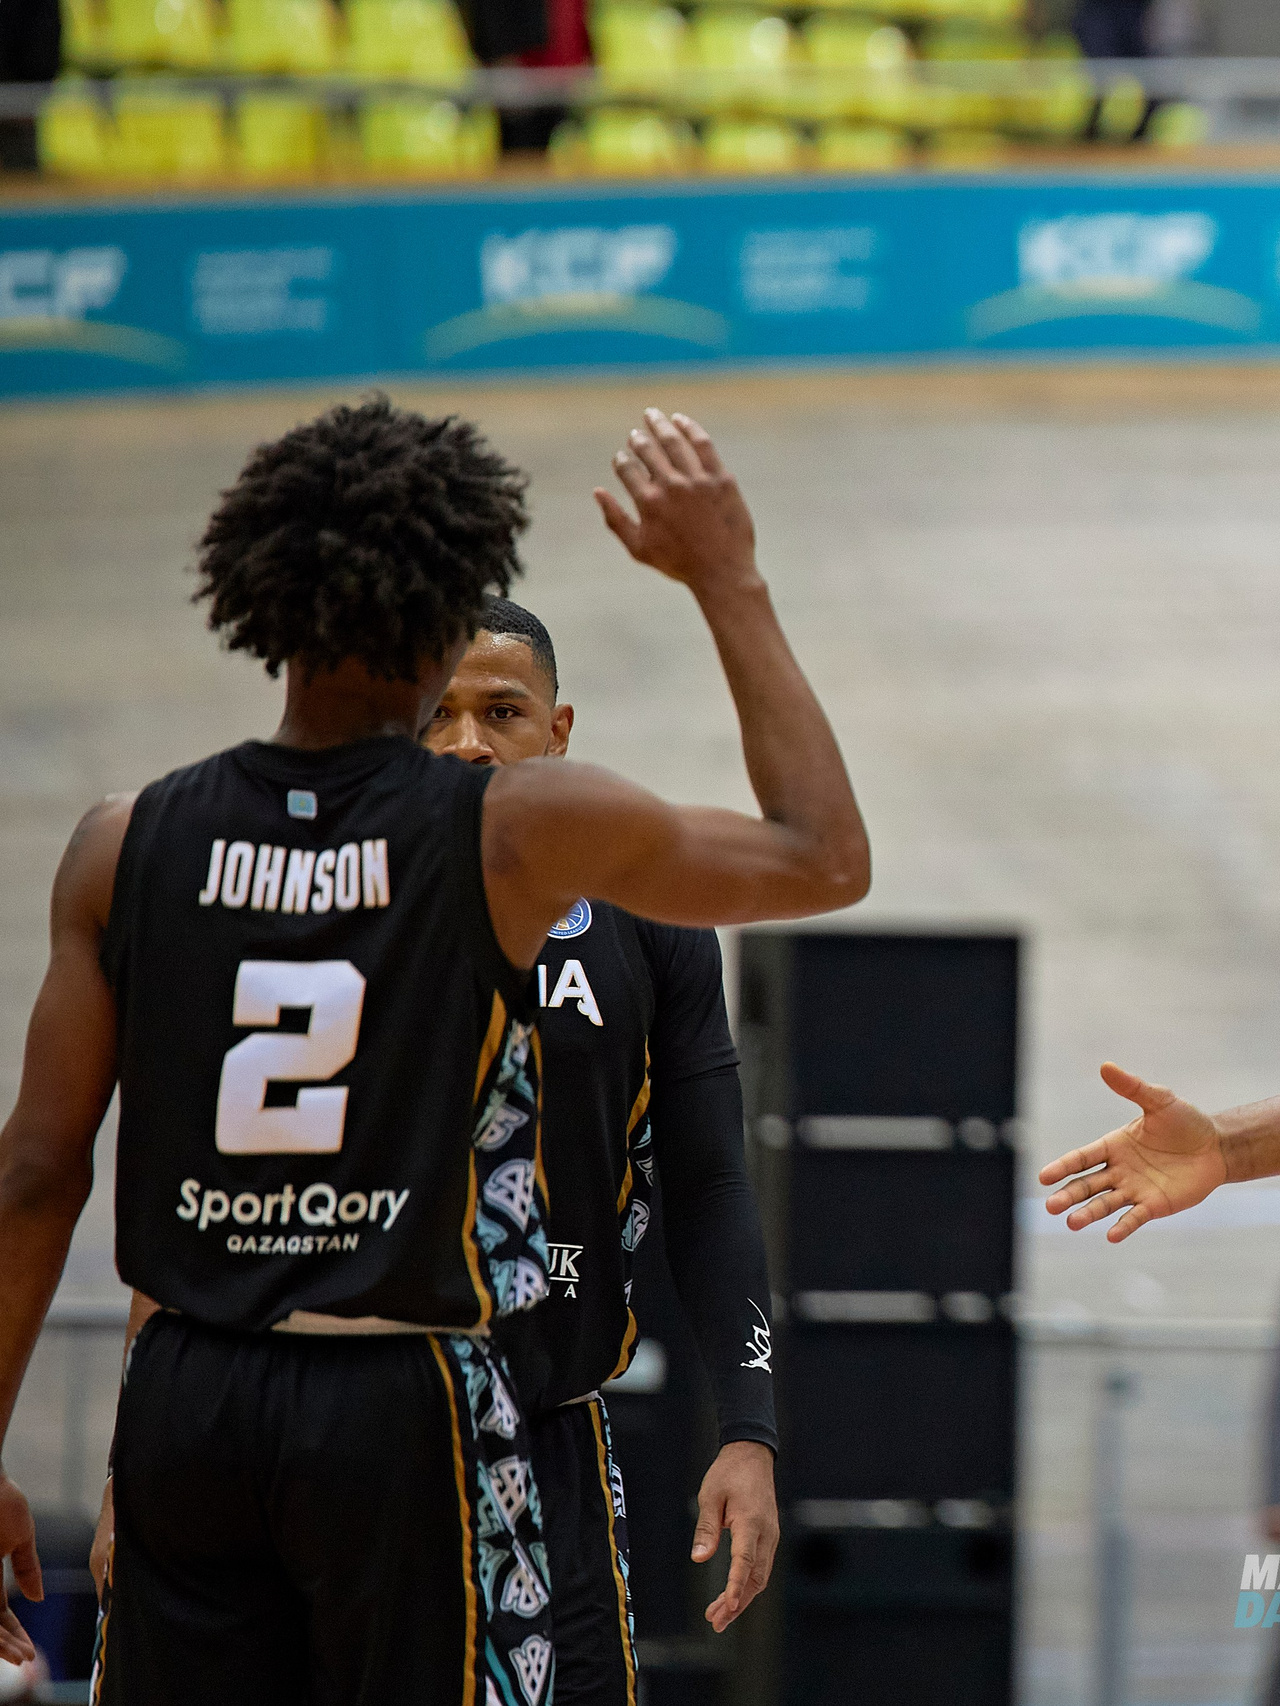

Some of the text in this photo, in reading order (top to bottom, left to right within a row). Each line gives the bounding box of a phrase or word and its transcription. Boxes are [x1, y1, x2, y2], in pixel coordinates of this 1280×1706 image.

[198, 838, 391, 915] JOHNSON
[215, 959, 367, 1155] 2
[176, 1178, 410, 1232] SportQory
[226, 1233, 359, 1255] QAZAQSTAN
